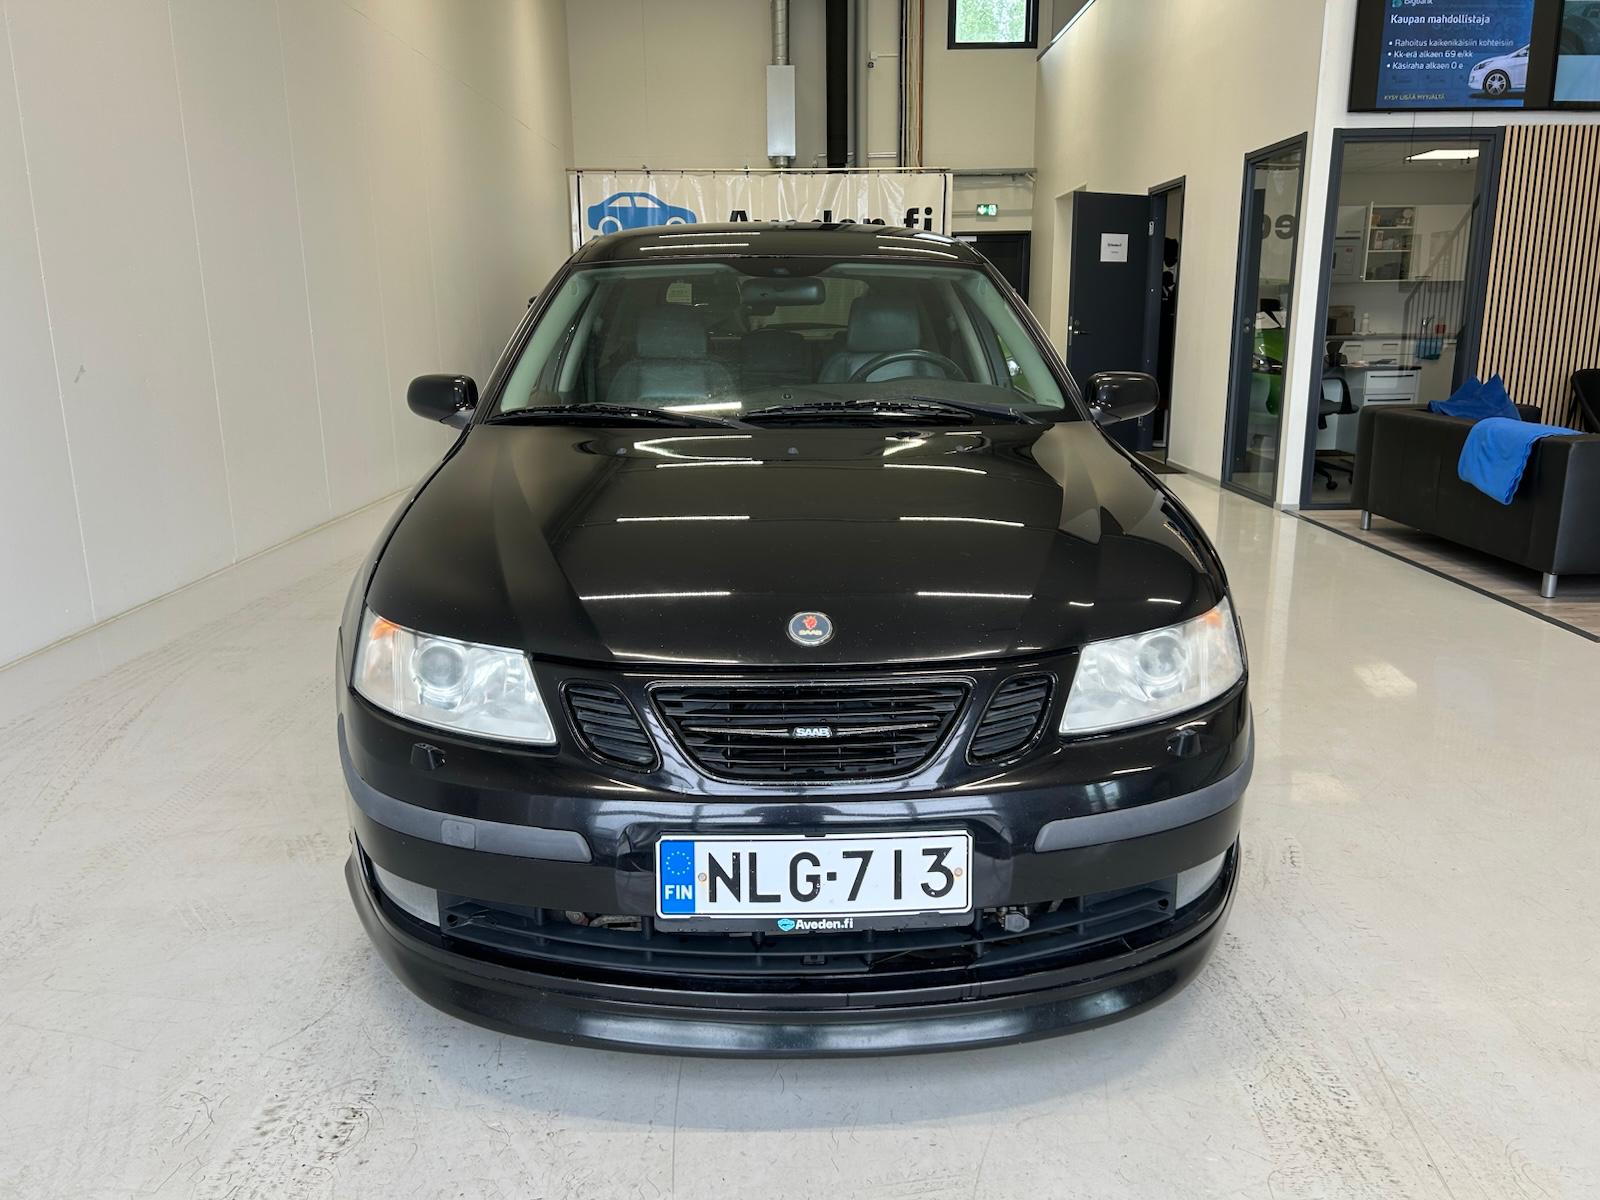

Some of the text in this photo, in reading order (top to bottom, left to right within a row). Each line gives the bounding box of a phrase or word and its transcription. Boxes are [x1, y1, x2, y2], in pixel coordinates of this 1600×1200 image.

[1391, 14, 1490, 26] Kaupan mahdollistaja
[1395, 39, 1427, 47] Rahoitus
[1479, 39, 1514, 47] kohteisiin
[1419, 50, 1443, 58] alkaen
[1444, 49, 1456, 58] 69
[1425, 61, 1449, 69] alkaen
[1450, 61, 1457, 69] 0
[795, 726, 831, 738] SAAB
[708, 846, 955, 903] NLG-713
[664, 884, 693, 900] FIN
[795, 917, 854, 930] Aveden.fi
